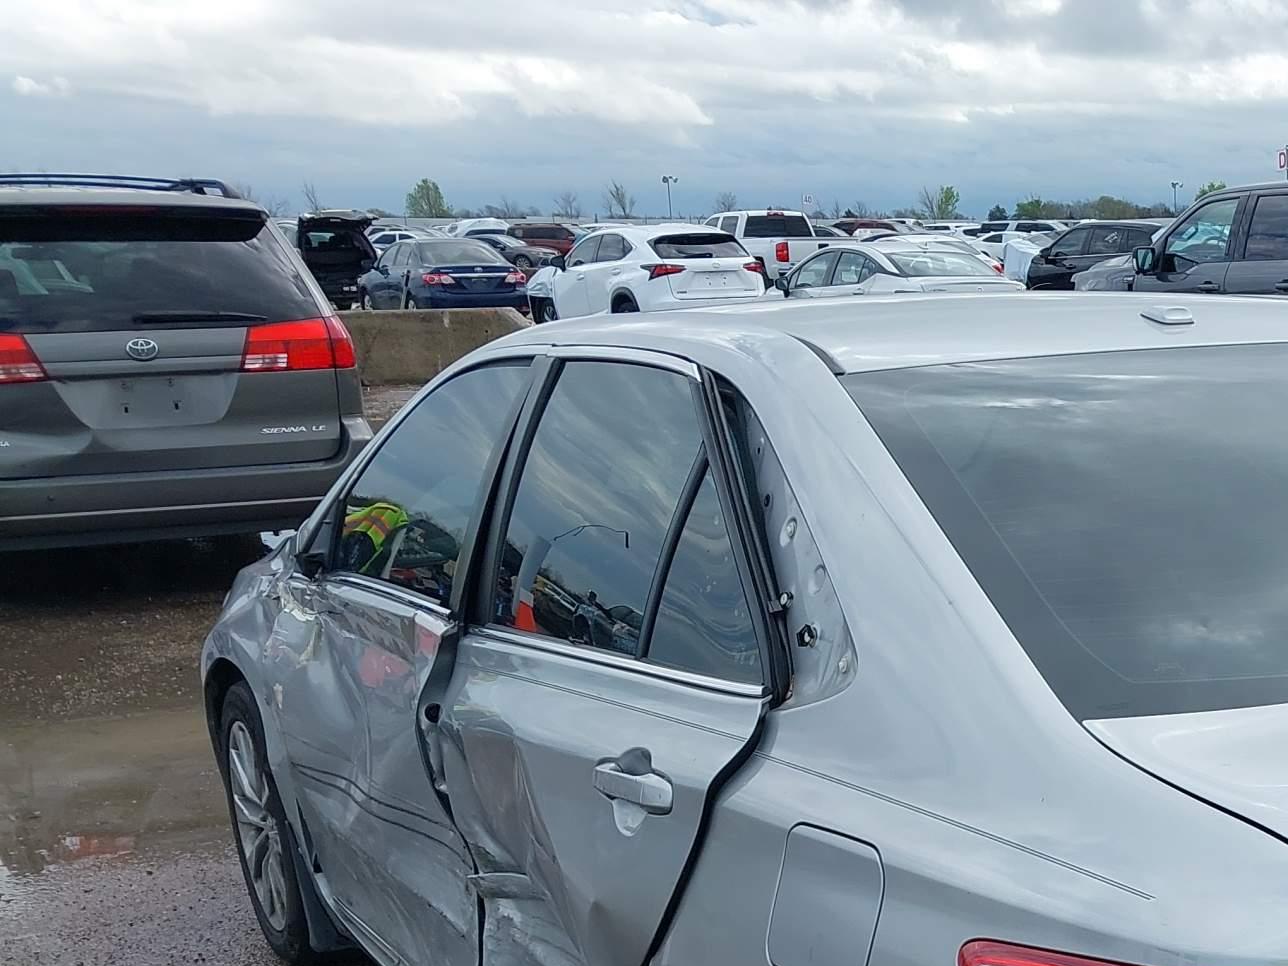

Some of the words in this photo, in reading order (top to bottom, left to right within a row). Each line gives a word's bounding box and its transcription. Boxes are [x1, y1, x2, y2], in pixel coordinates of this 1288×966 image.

[1279, 151, 1286, 169] D
[260, 425, 307, 434] SIENNA
[312, 424, 327, 432] LE
